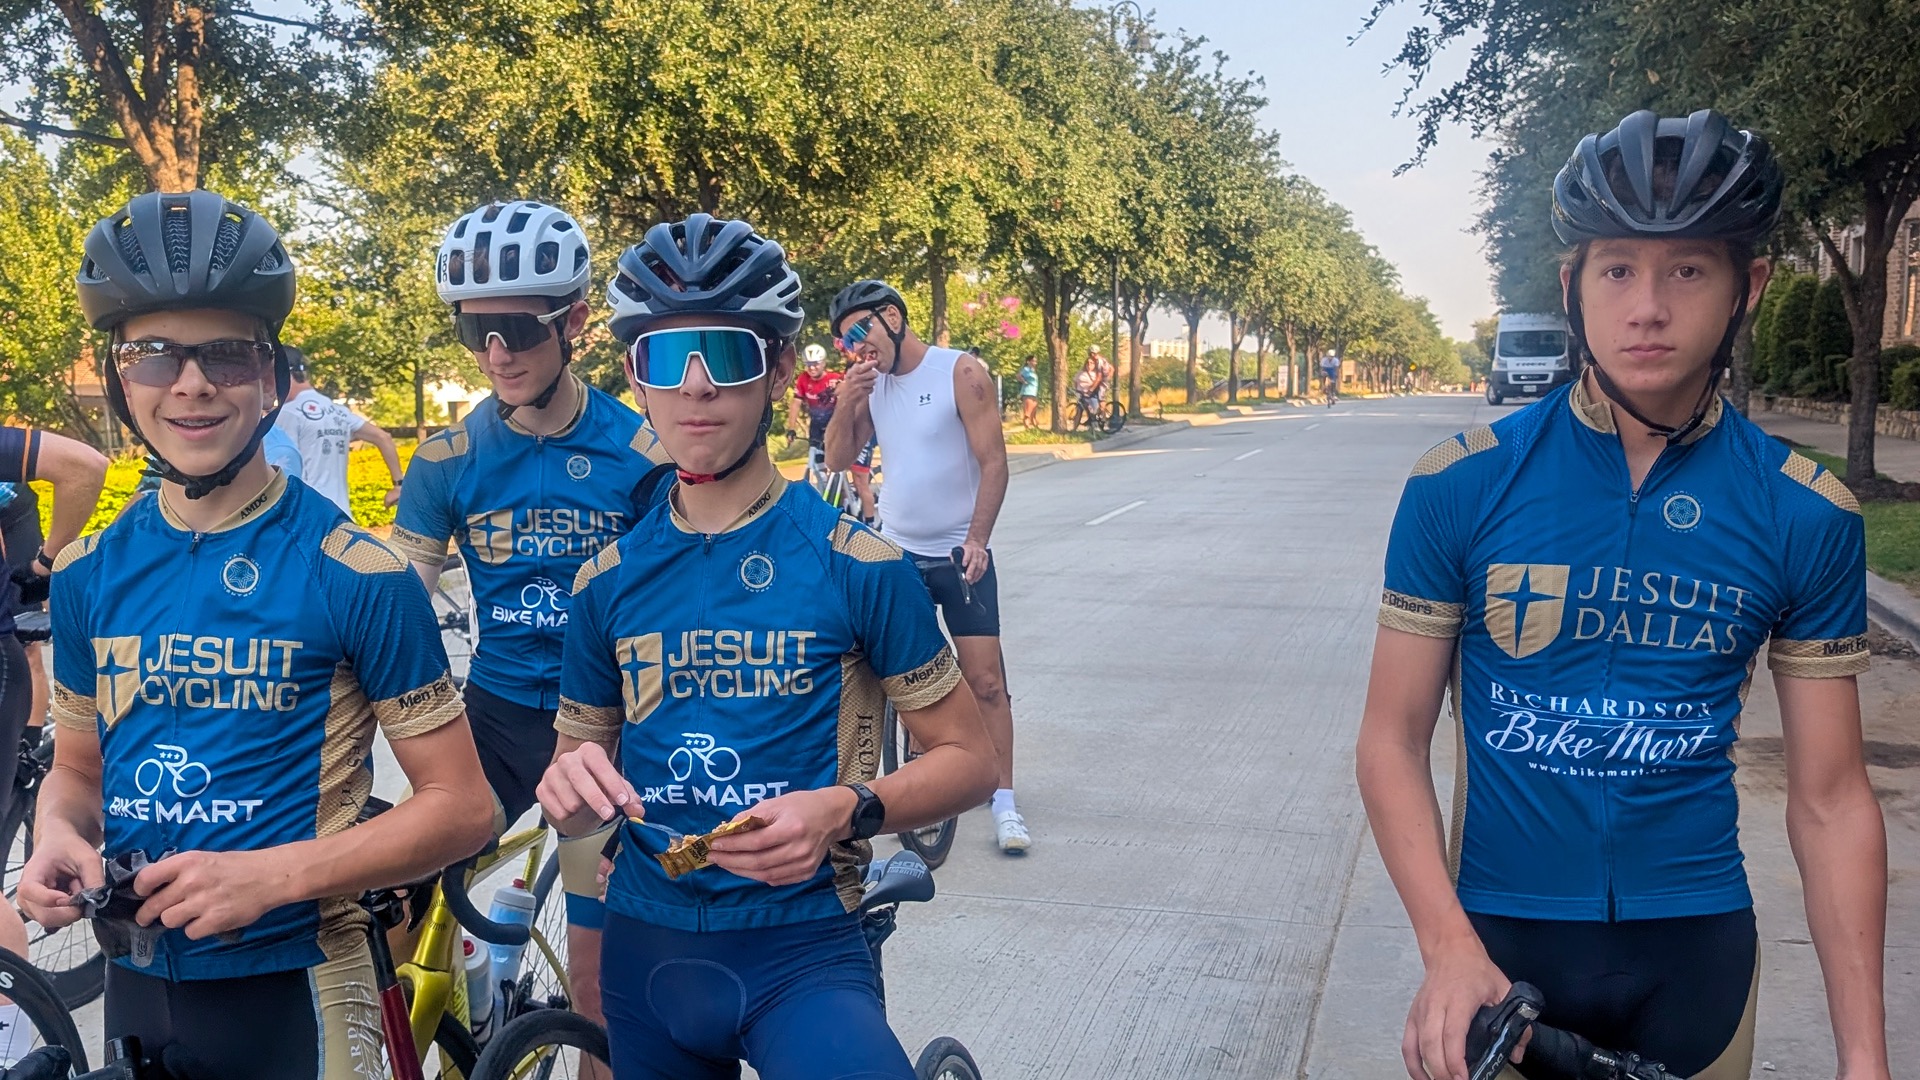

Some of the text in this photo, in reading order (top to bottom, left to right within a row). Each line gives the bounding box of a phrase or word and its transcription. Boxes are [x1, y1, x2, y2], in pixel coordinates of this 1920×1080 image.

[240, 493, 268, 520] AMDG
[748, 492, 771, 518] AMDG
[516, 508, 623, 535] JESUIT
[1389, 593, 1432, 615] Others
[1577, 566, 1753, 617] JESUIT
[492, 605, 568, 629] BIKE MA
[1572, 607, 1743, 655] DALLAS
[146, 633, 304, 678] JESUIT
[668, 629, 817, 668] JESUIT
[1823, 640, 1855, 655] Men
[668, 668, 814, 699] CYCLING
[903, 666, 934, 686] Men
[140, 675, 301, 712] CYCLING
[398, 690, 431, 710] Men
[1490, 681, 1715, 720] RICHARDSON
[856, 712, 875, 777] JESUI
[1485, 710, 1721, 766] Bike Mart
[1528, 761, 1679, 778] www.bikemart.co
[692, 781, 789, 807] MART
[109, 796, 264, 824] BIKE MART
